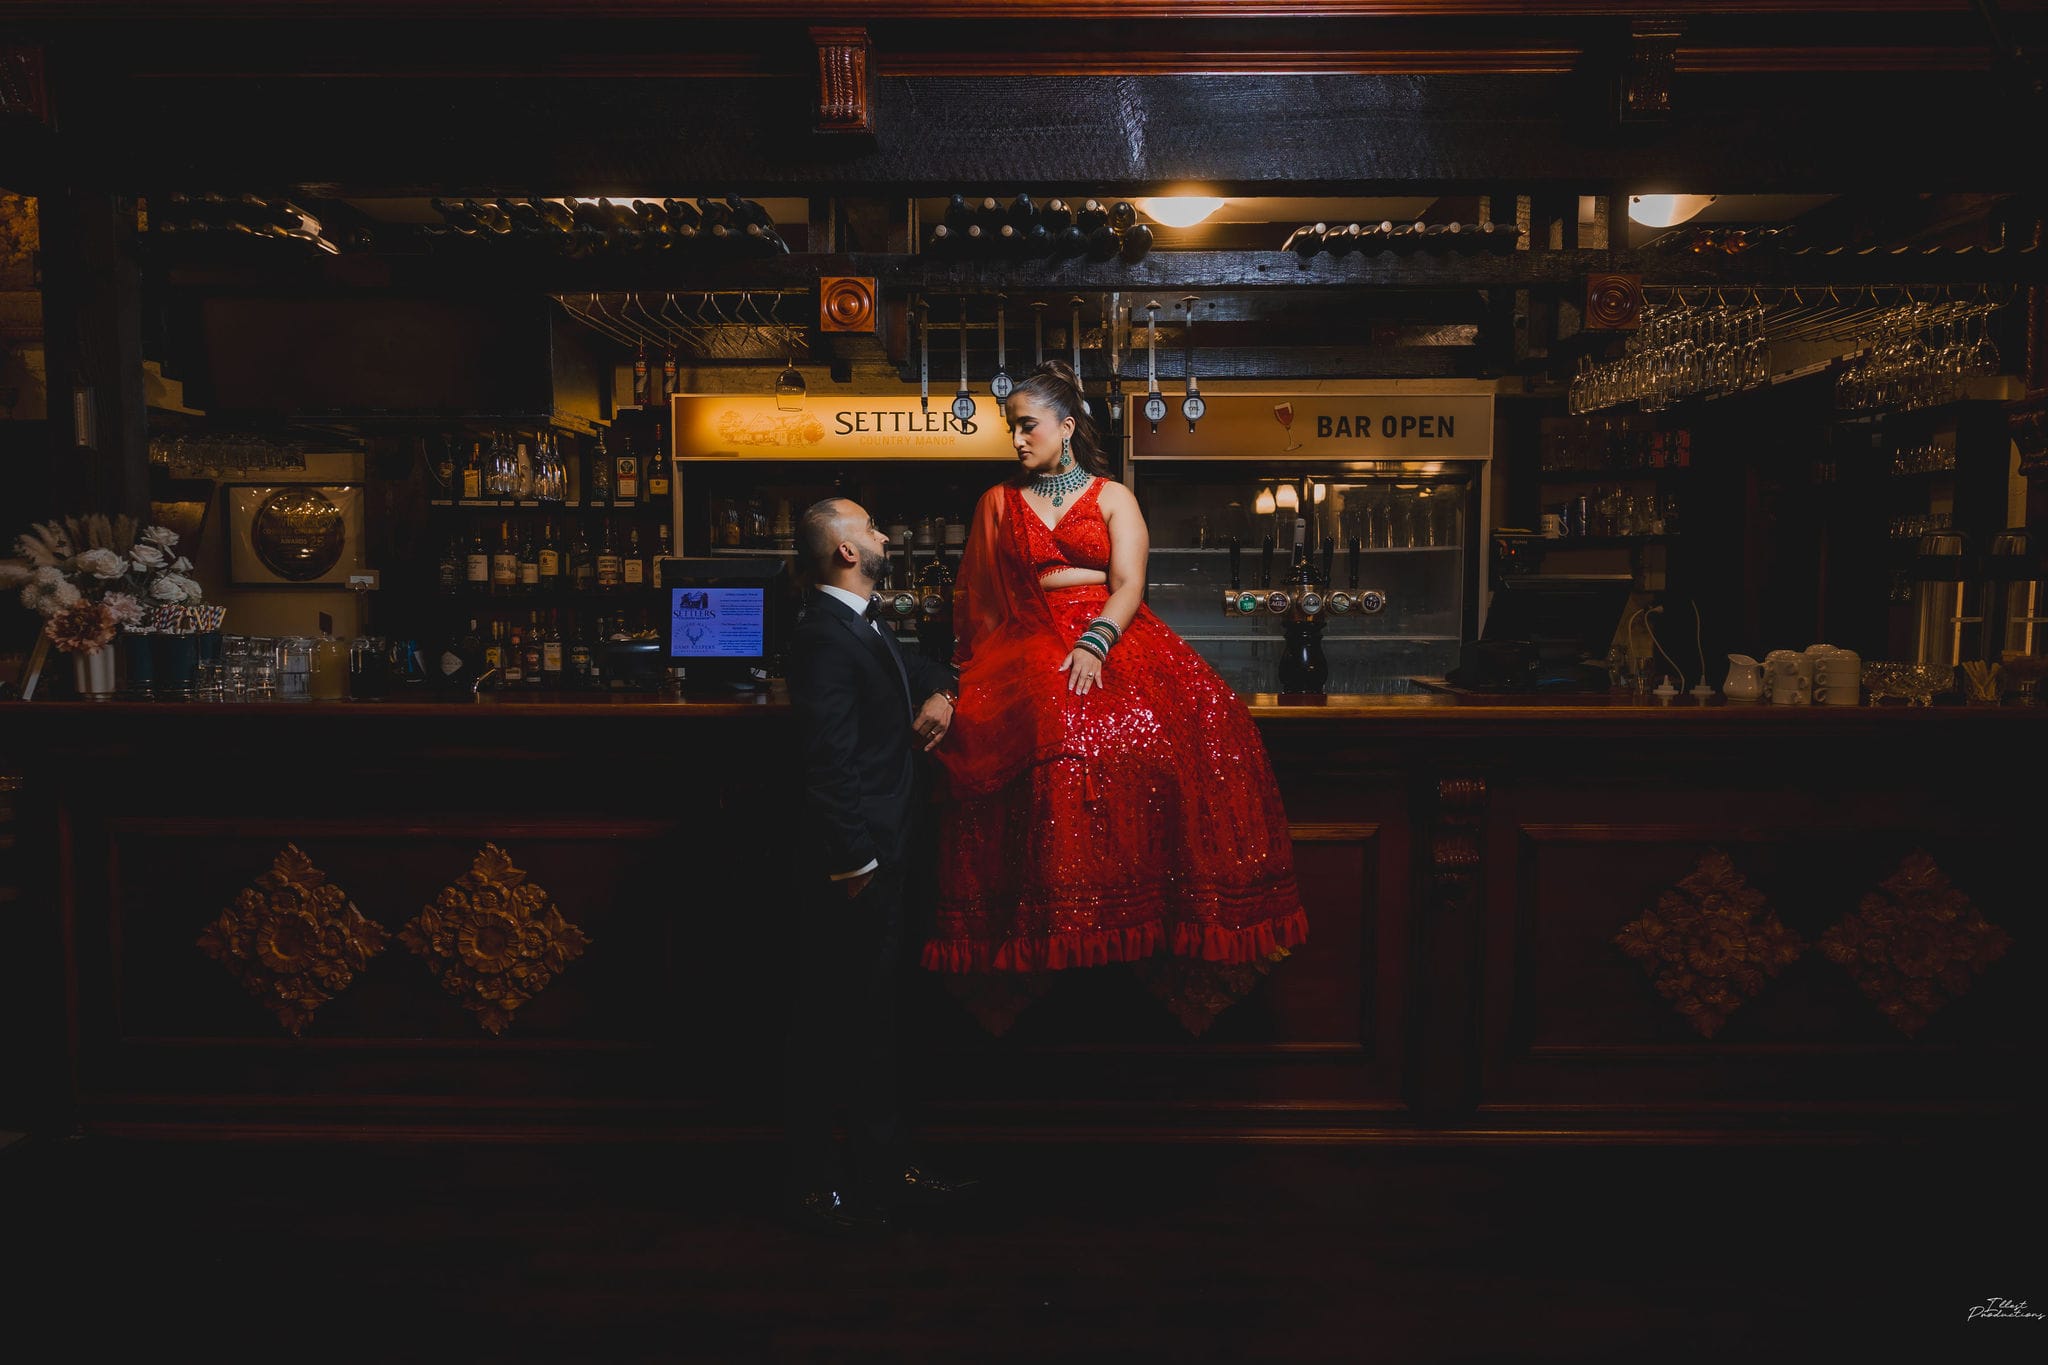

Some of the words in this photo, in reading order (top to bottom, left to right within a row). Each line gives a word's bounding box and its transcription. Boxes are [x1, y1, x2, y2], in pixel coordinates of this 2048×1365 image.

[834, 411, 978, 435] SETTLERS
[1317, 415, 1371, 438] BAR
[1382, 415, 1455, 438] OPEN
[859, 435, 912, 446] COUNTRY
[915, 435, 956, 446] MANOR
